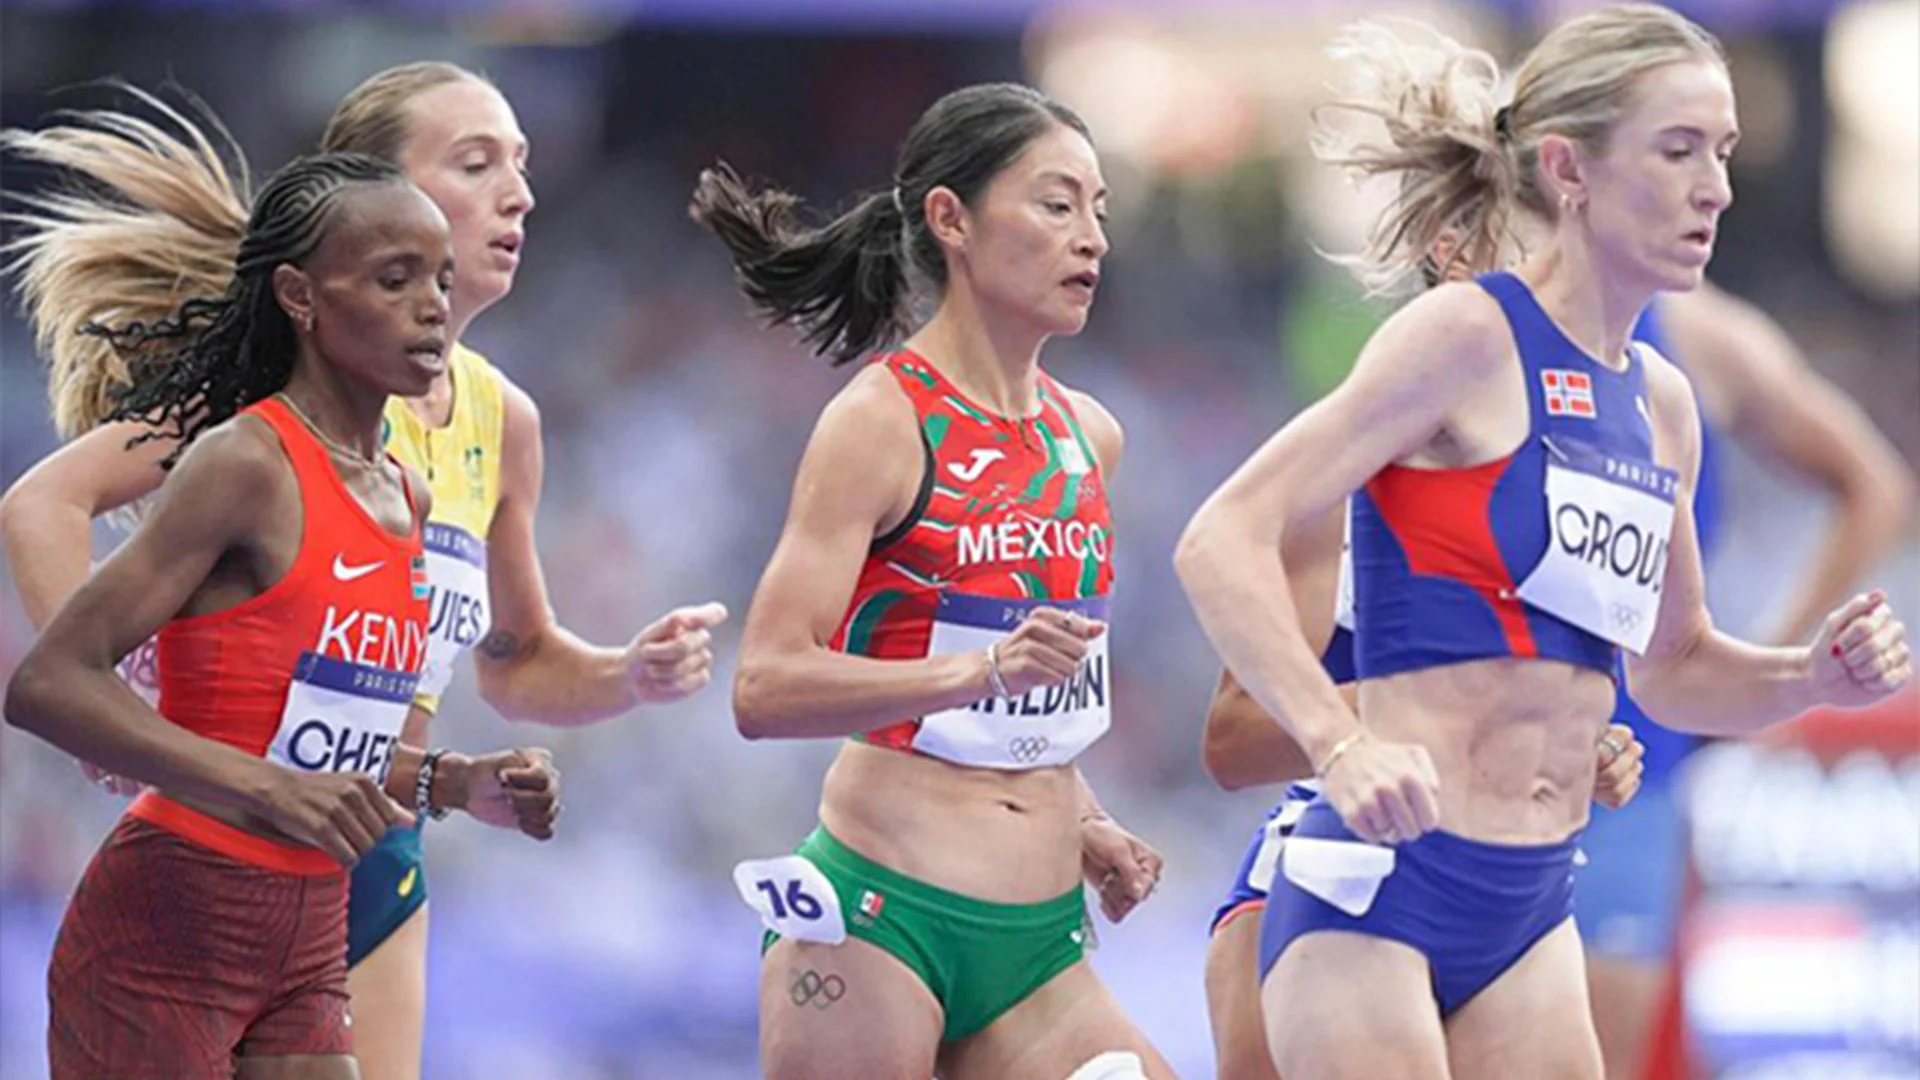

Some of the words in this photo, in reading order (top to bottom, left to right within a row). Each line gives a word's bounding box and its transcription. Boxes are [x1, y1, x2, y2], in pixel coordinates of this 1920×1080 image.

[1605, 457, 1659, 490] PARIS
[957, 513, 1107, 566] MÉXICO
[757, 879, 823, 921] 16
